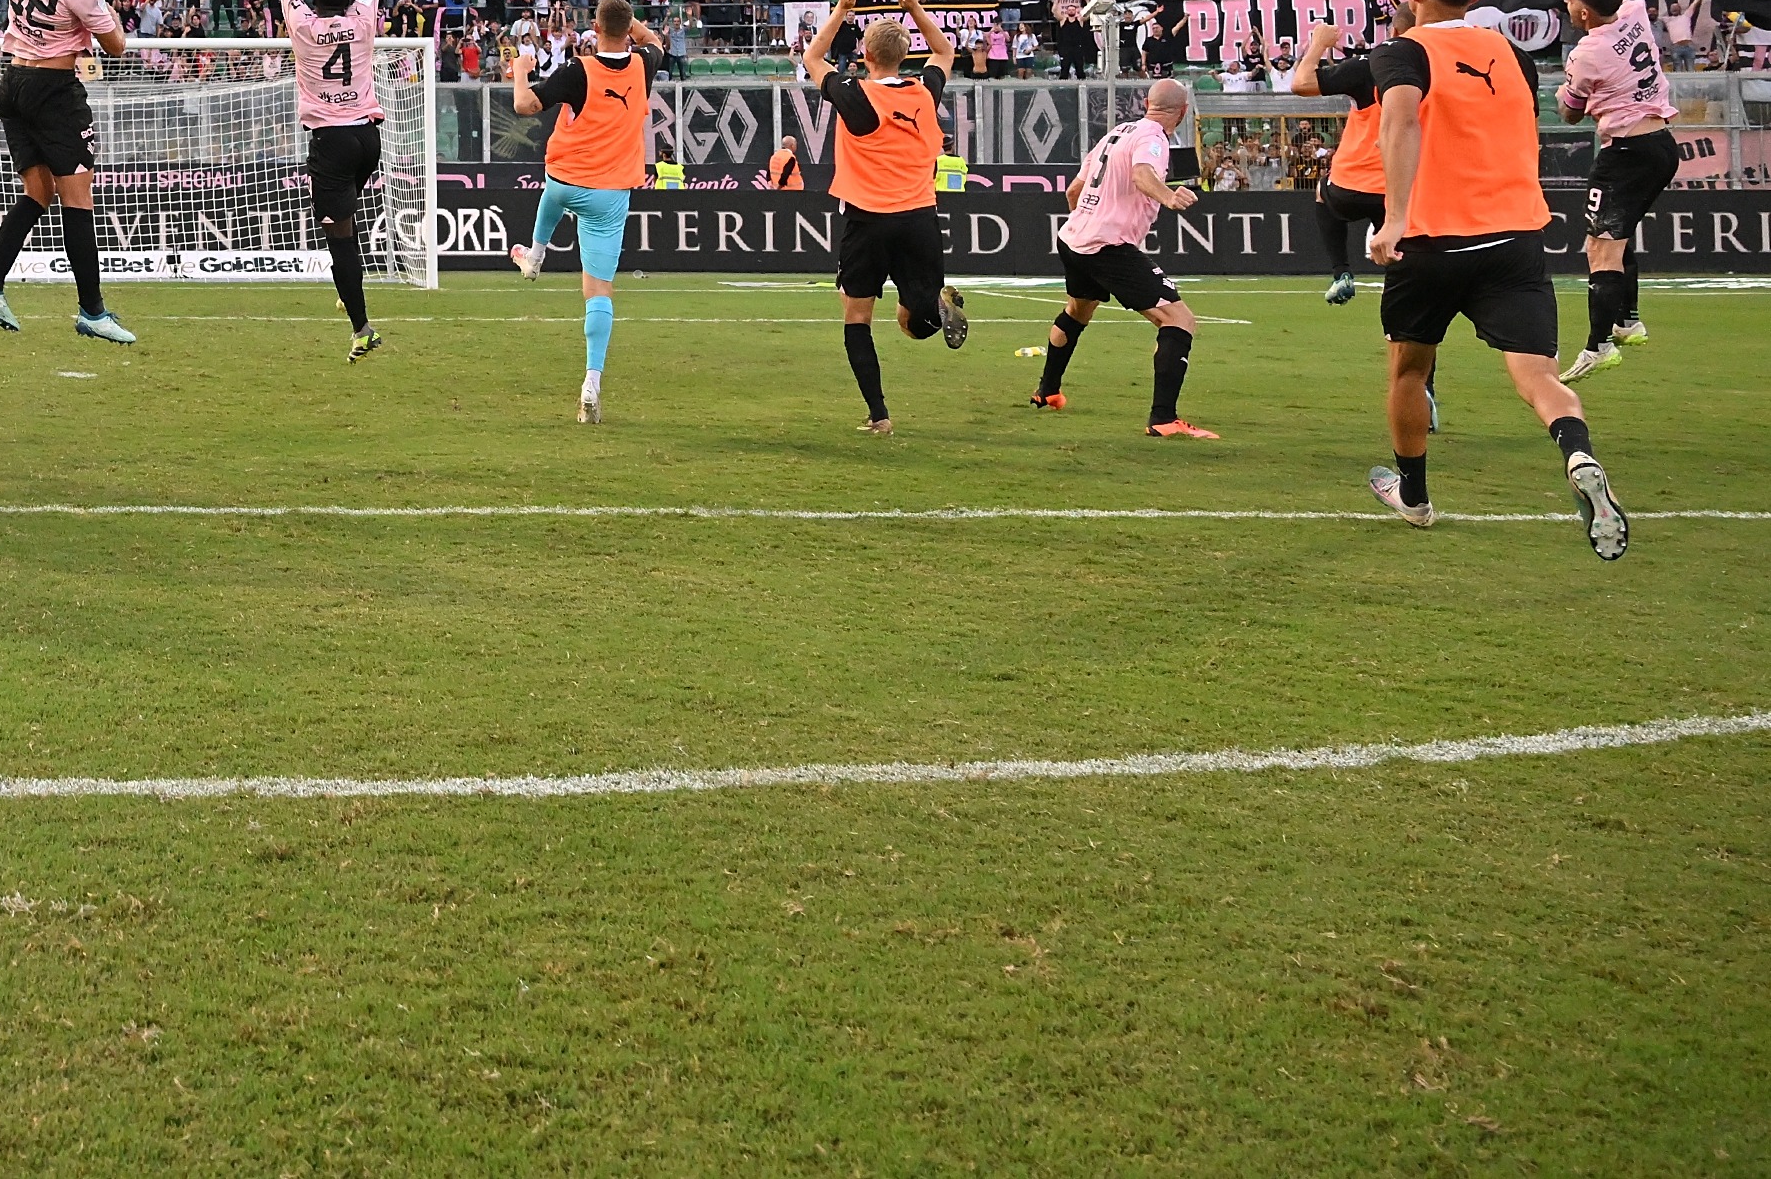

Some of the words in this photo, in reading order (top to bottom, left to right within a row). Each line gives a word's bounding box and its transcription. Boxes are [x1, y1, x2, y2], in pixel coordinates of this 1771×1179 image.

[317, 30, 355, 45] GOMES
[1612, 21, 1645, 57] BRUNORI
[322, 42, 352, 87] 4
[1628, 41, 1658, 90] 9
[158, 171, 243, 189] SPECIALI
[1587, 187, 1603, 211] 9
[200, 257, 304, 274] GoldBet
